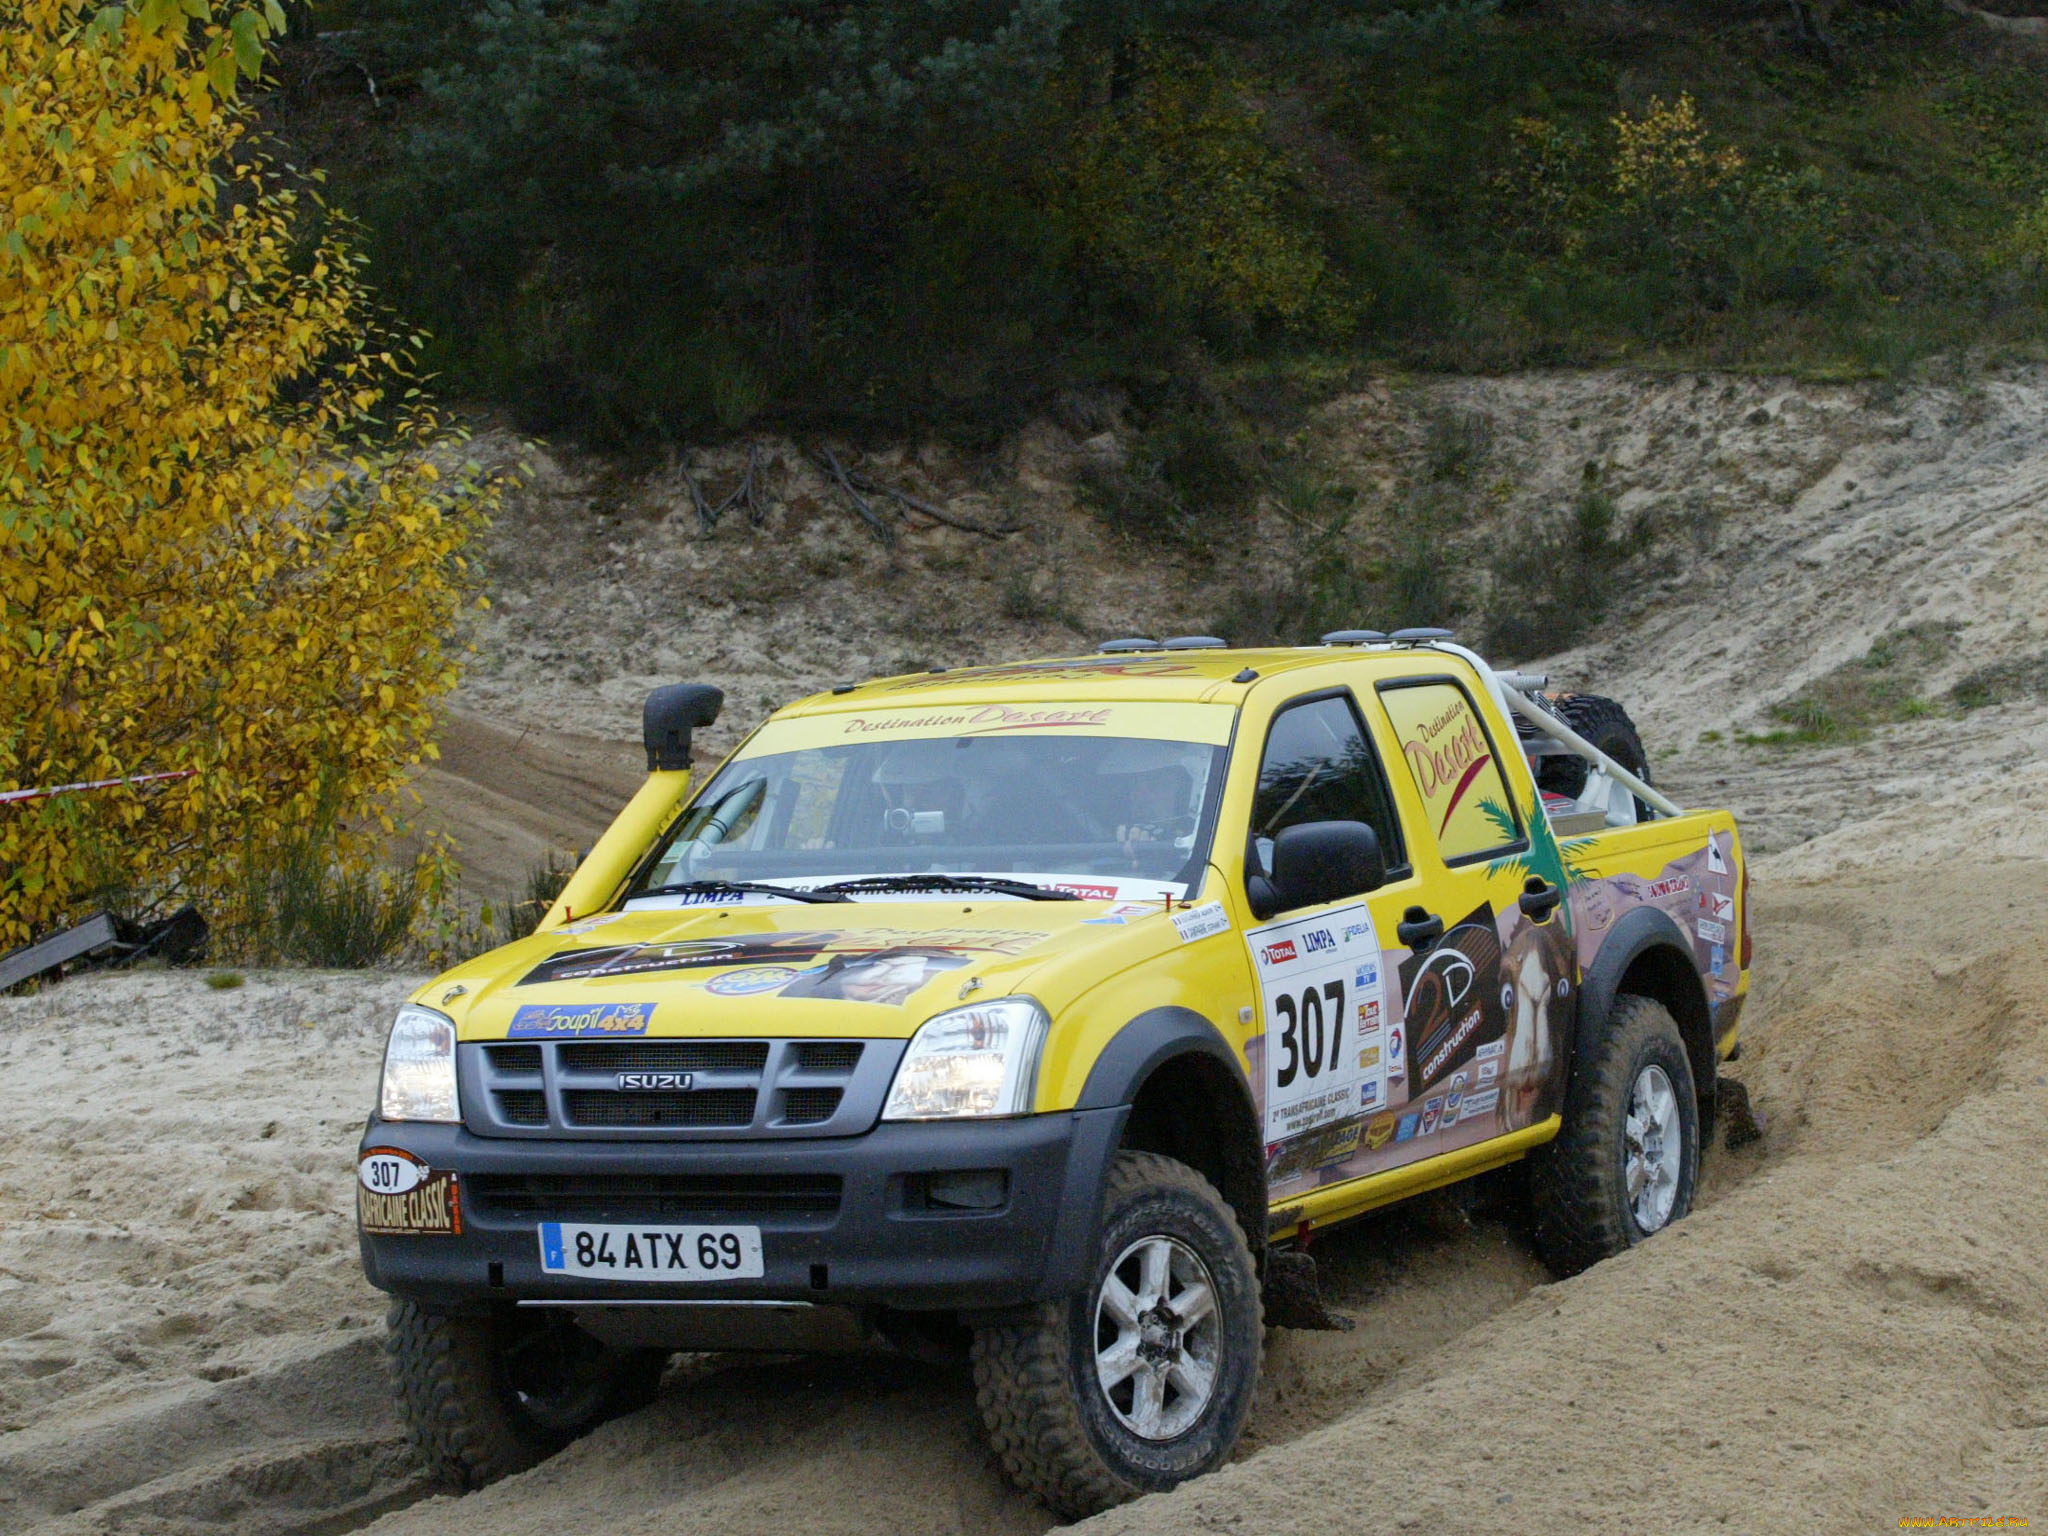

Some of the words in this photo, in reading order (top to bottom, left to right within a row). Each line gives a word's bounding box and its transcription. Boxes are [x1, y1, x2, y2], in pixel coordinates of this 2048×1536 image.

[844, 714, 965, 734] Destination
[966, 704, 1113, 723] Desert
[1417, 701, 1464, 742] Destination
[1404, 714, 1484, 798] Desert
[1269, 946, 1295, 960] TOTAL
[1302, 929, 1336, 953] LIMPA
[560, 953, 733, 978] construction
[598, 1014, 645, 1031] 4x4
[1275, 979, 1345, 1087] 307
[1423, 1009, 1480, 1081] construction
[619, 1075, 691, 1089] ISUZU
[371, 1161, 399, 1187] 307
[409, 1177, 450, 1228] CLASSIC
[576, 1231, 616, 1267] 84
[625, 1233, 688, 1268] ATX
[698, 1233, 741, 1269] 69
